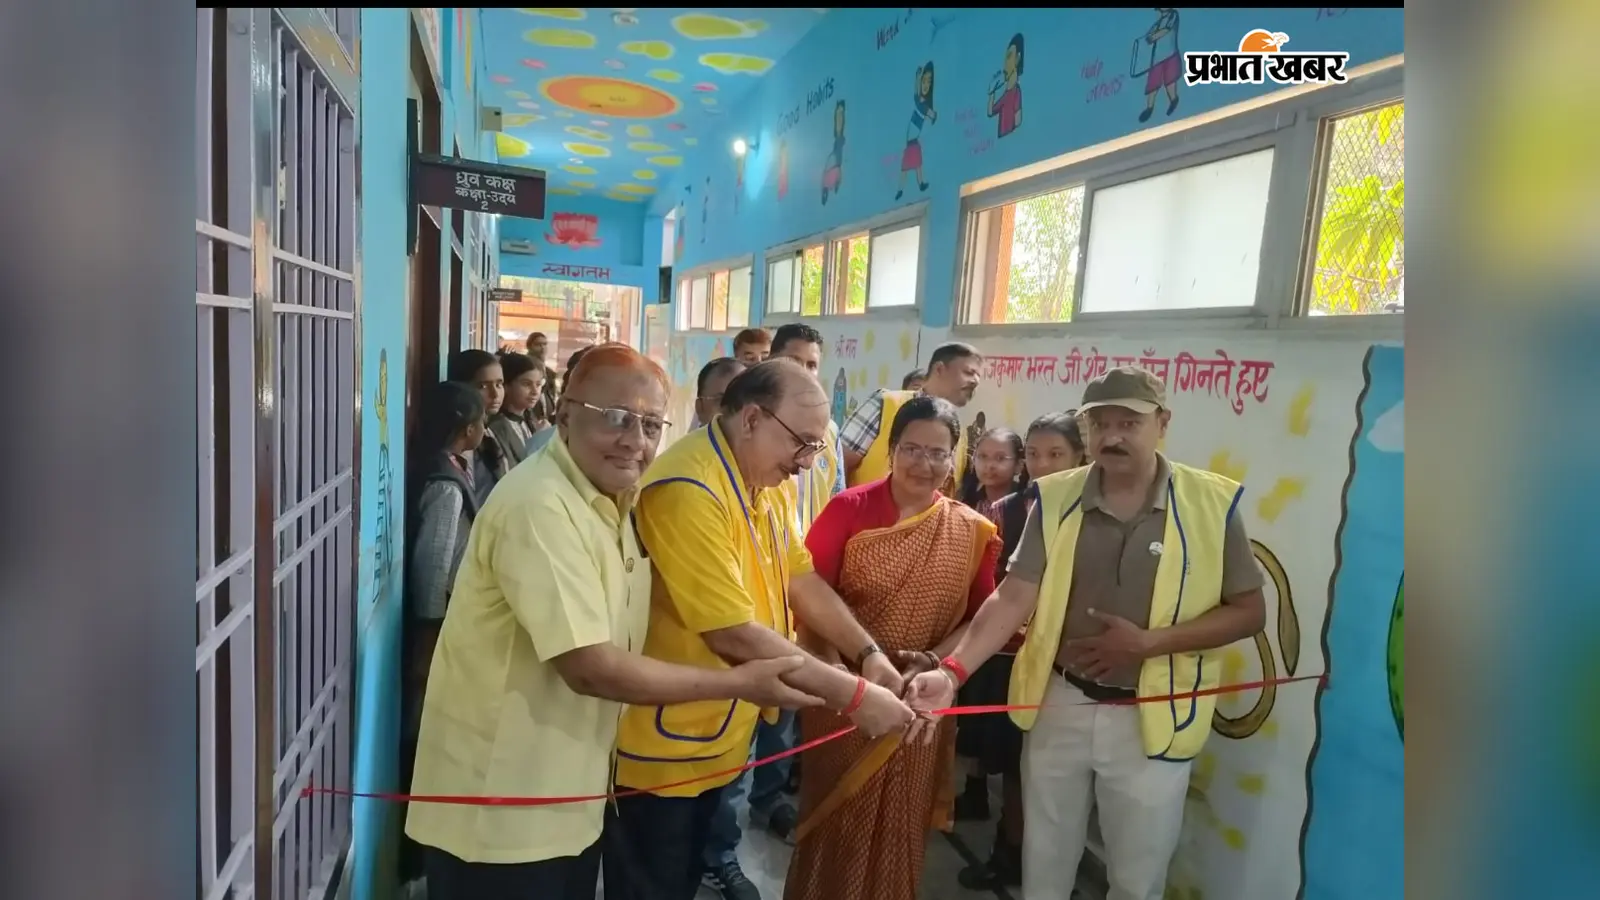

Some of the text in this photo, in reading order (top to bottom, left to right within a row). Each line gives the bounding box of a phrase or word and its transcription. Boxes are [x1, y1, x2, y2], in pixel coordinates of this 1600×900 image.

[484, 175, 516, 193] कक्ष
[481, 201, 489, 211] 2
[1026, 356, 1059, 386] भरत
[1058, 346, 1083, 385] जी
[1174, 349, 1236, 400] गिनते
